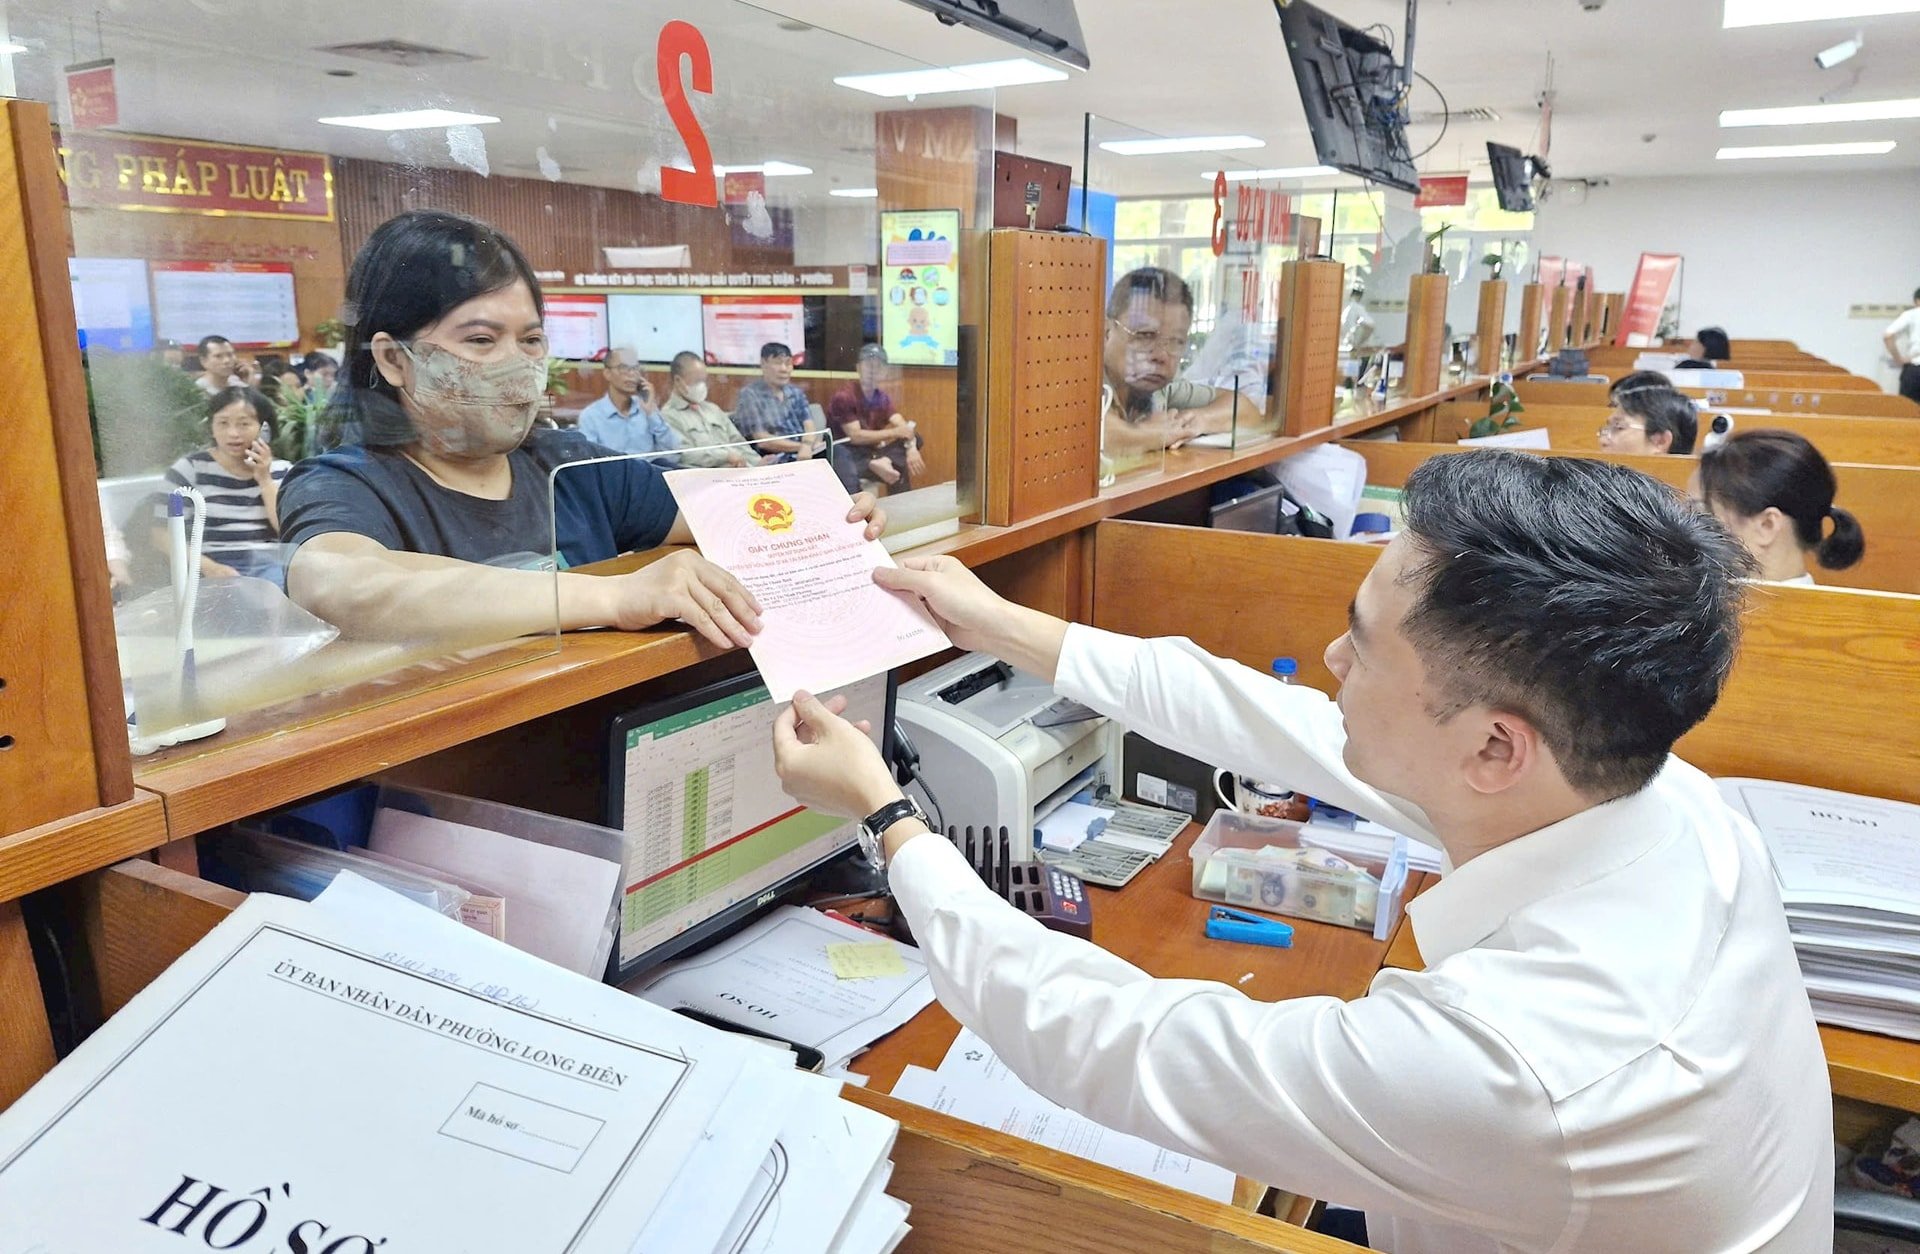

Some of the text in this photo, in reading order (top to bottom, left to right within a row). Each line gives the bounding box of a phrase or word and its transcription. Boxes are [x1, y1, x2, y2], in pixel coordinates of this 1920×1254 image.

[114, 148, 218, 197] PHÁP
[226, 157, 309, 210] LUẬT
[757, 890, 776, 906] DELL
[274, 958, 629, 1087] ỦY BAN NHÂN DÂN PHƯỜNG LONG BIÊN
[464, 1105, 487, 1121] Mã
[139, 1174, 290, 1250] HỒ
